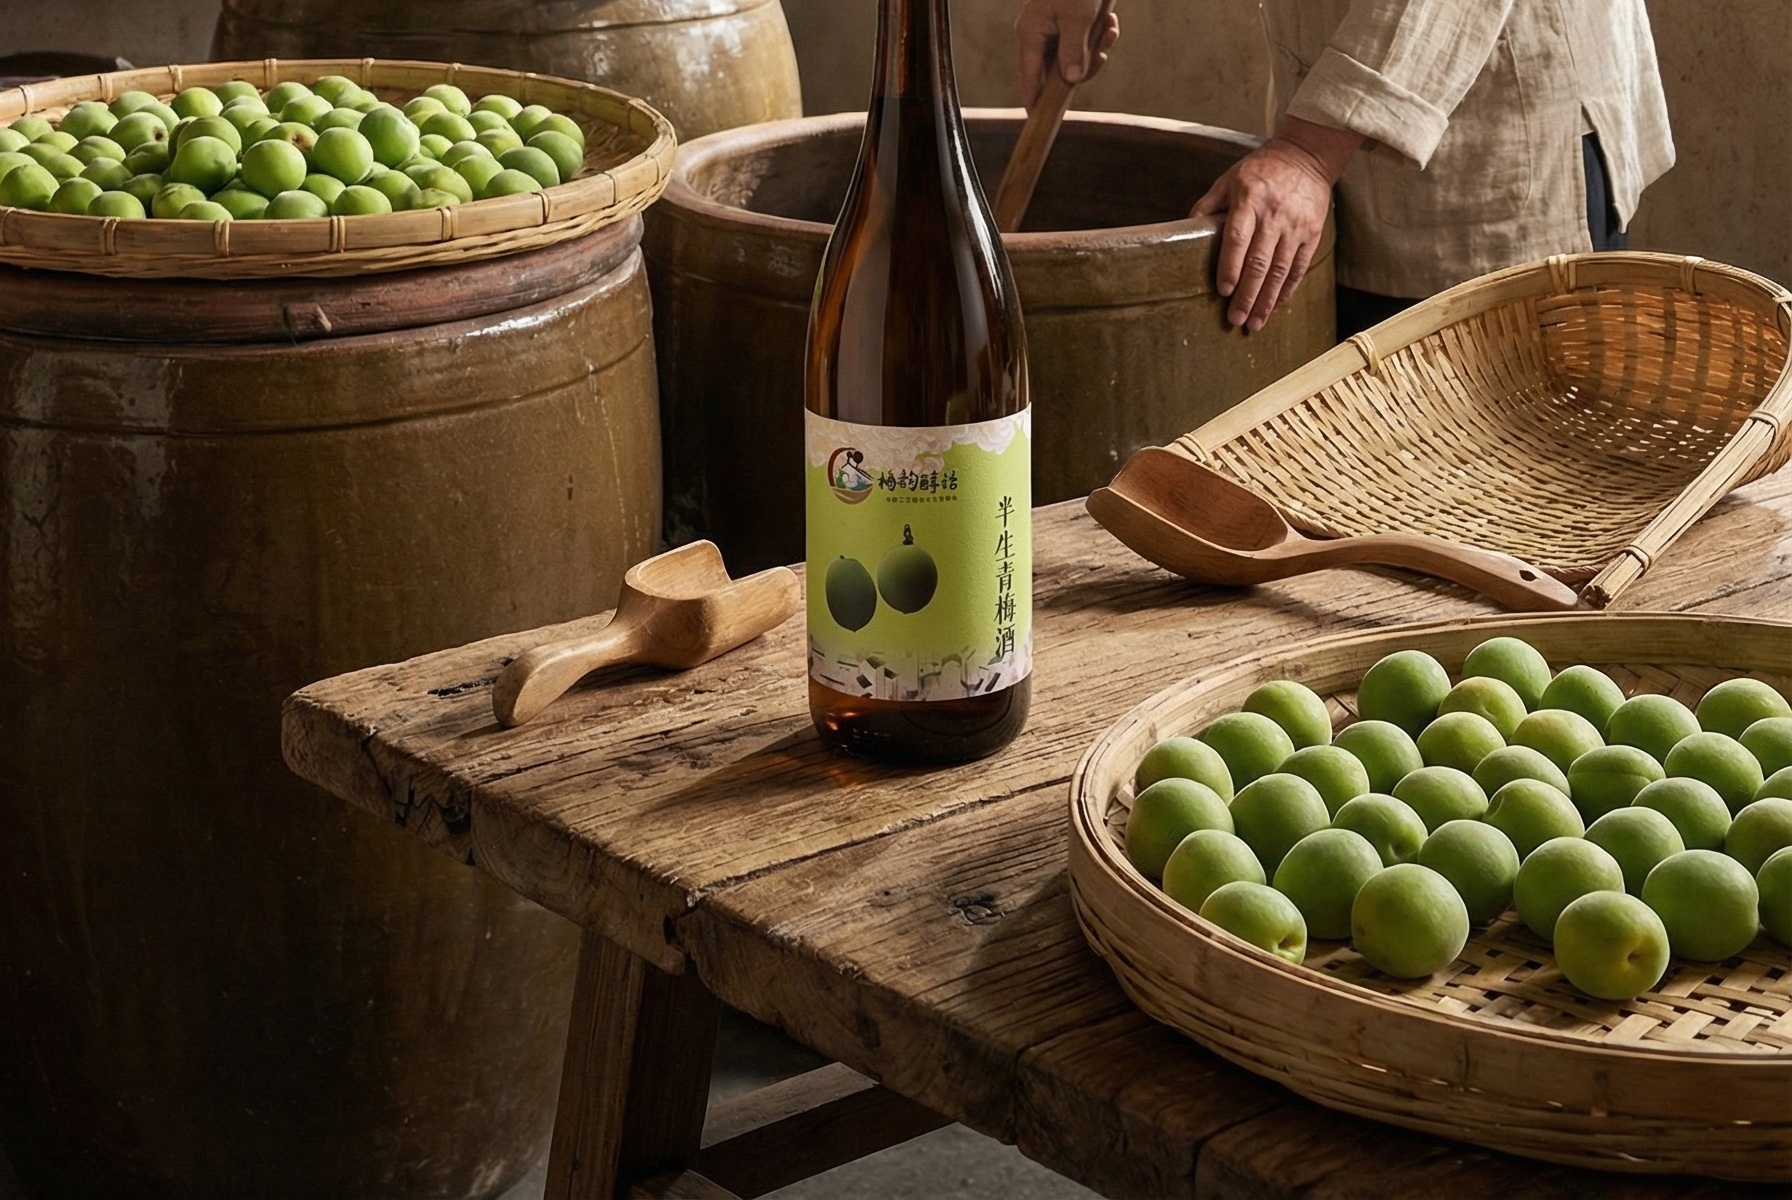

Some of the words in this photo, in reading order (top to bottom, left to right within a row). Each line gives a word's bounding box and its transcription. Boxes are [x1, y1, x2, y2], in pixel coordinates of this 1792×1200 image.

[994, 495, 1017, 660] 半生青梅酒
